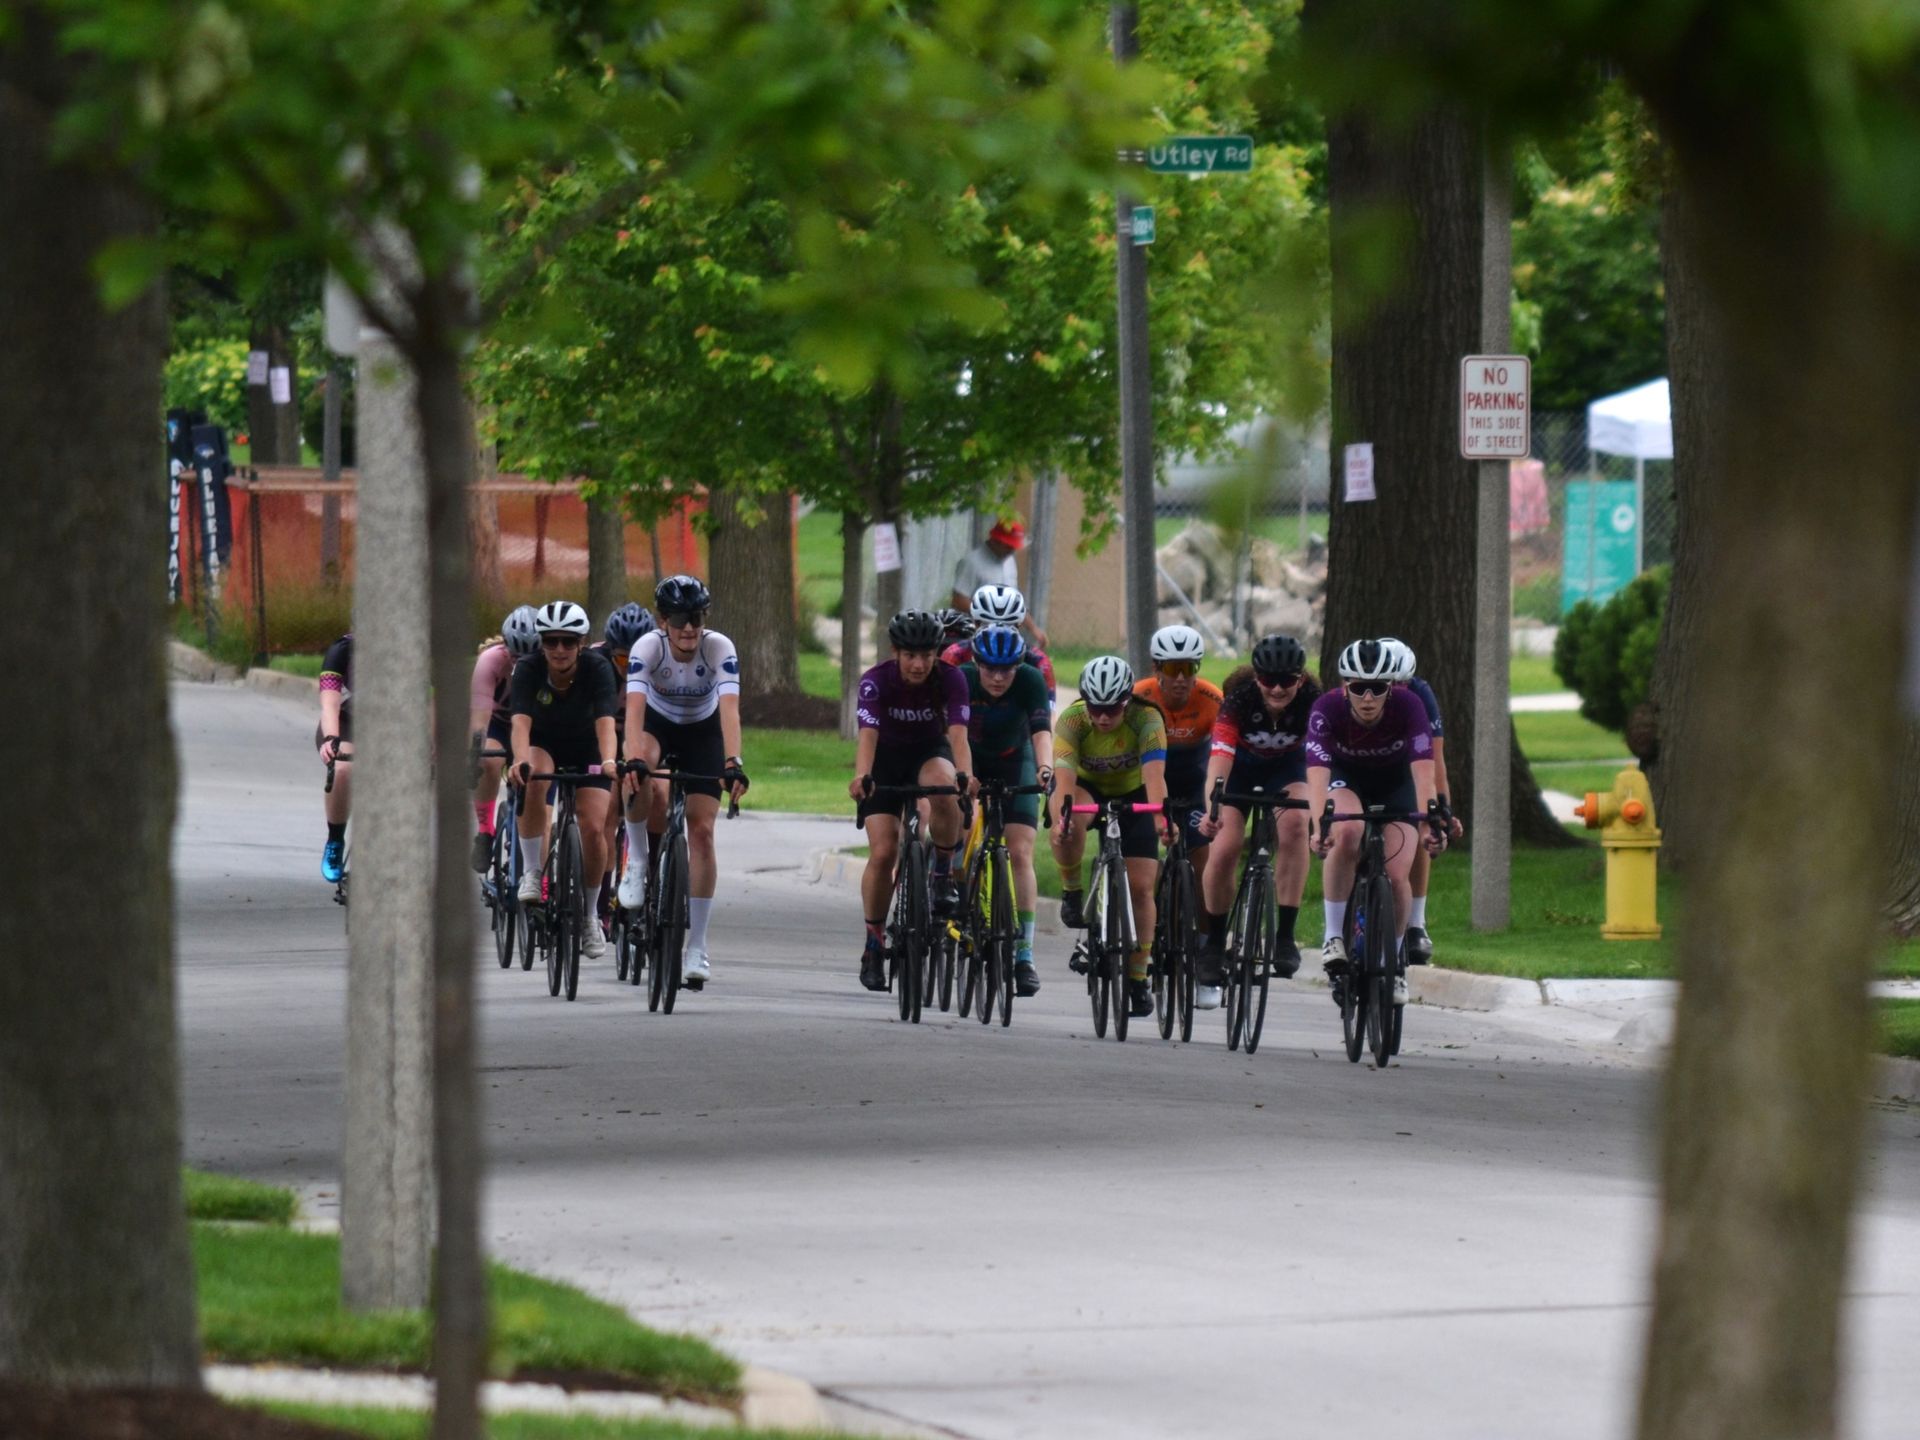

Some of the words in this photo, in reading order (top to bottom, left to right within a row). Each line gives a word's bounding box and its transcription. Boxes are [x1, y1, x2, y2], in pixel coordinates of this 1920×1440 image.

[1151, 145, 1218, 170] Utley
[1225, 147, 1249, 162] Rd
[1484, 367, 1508, 385] NO
[1467, 392, 1525, 410] PARKING
[1470, 417, 1493, 429] THIS
[1499, 416, 1521, 429] SIDE
[1467, 435, 1480, 448] OF
[1486, 435, 1525, 448] STREET
